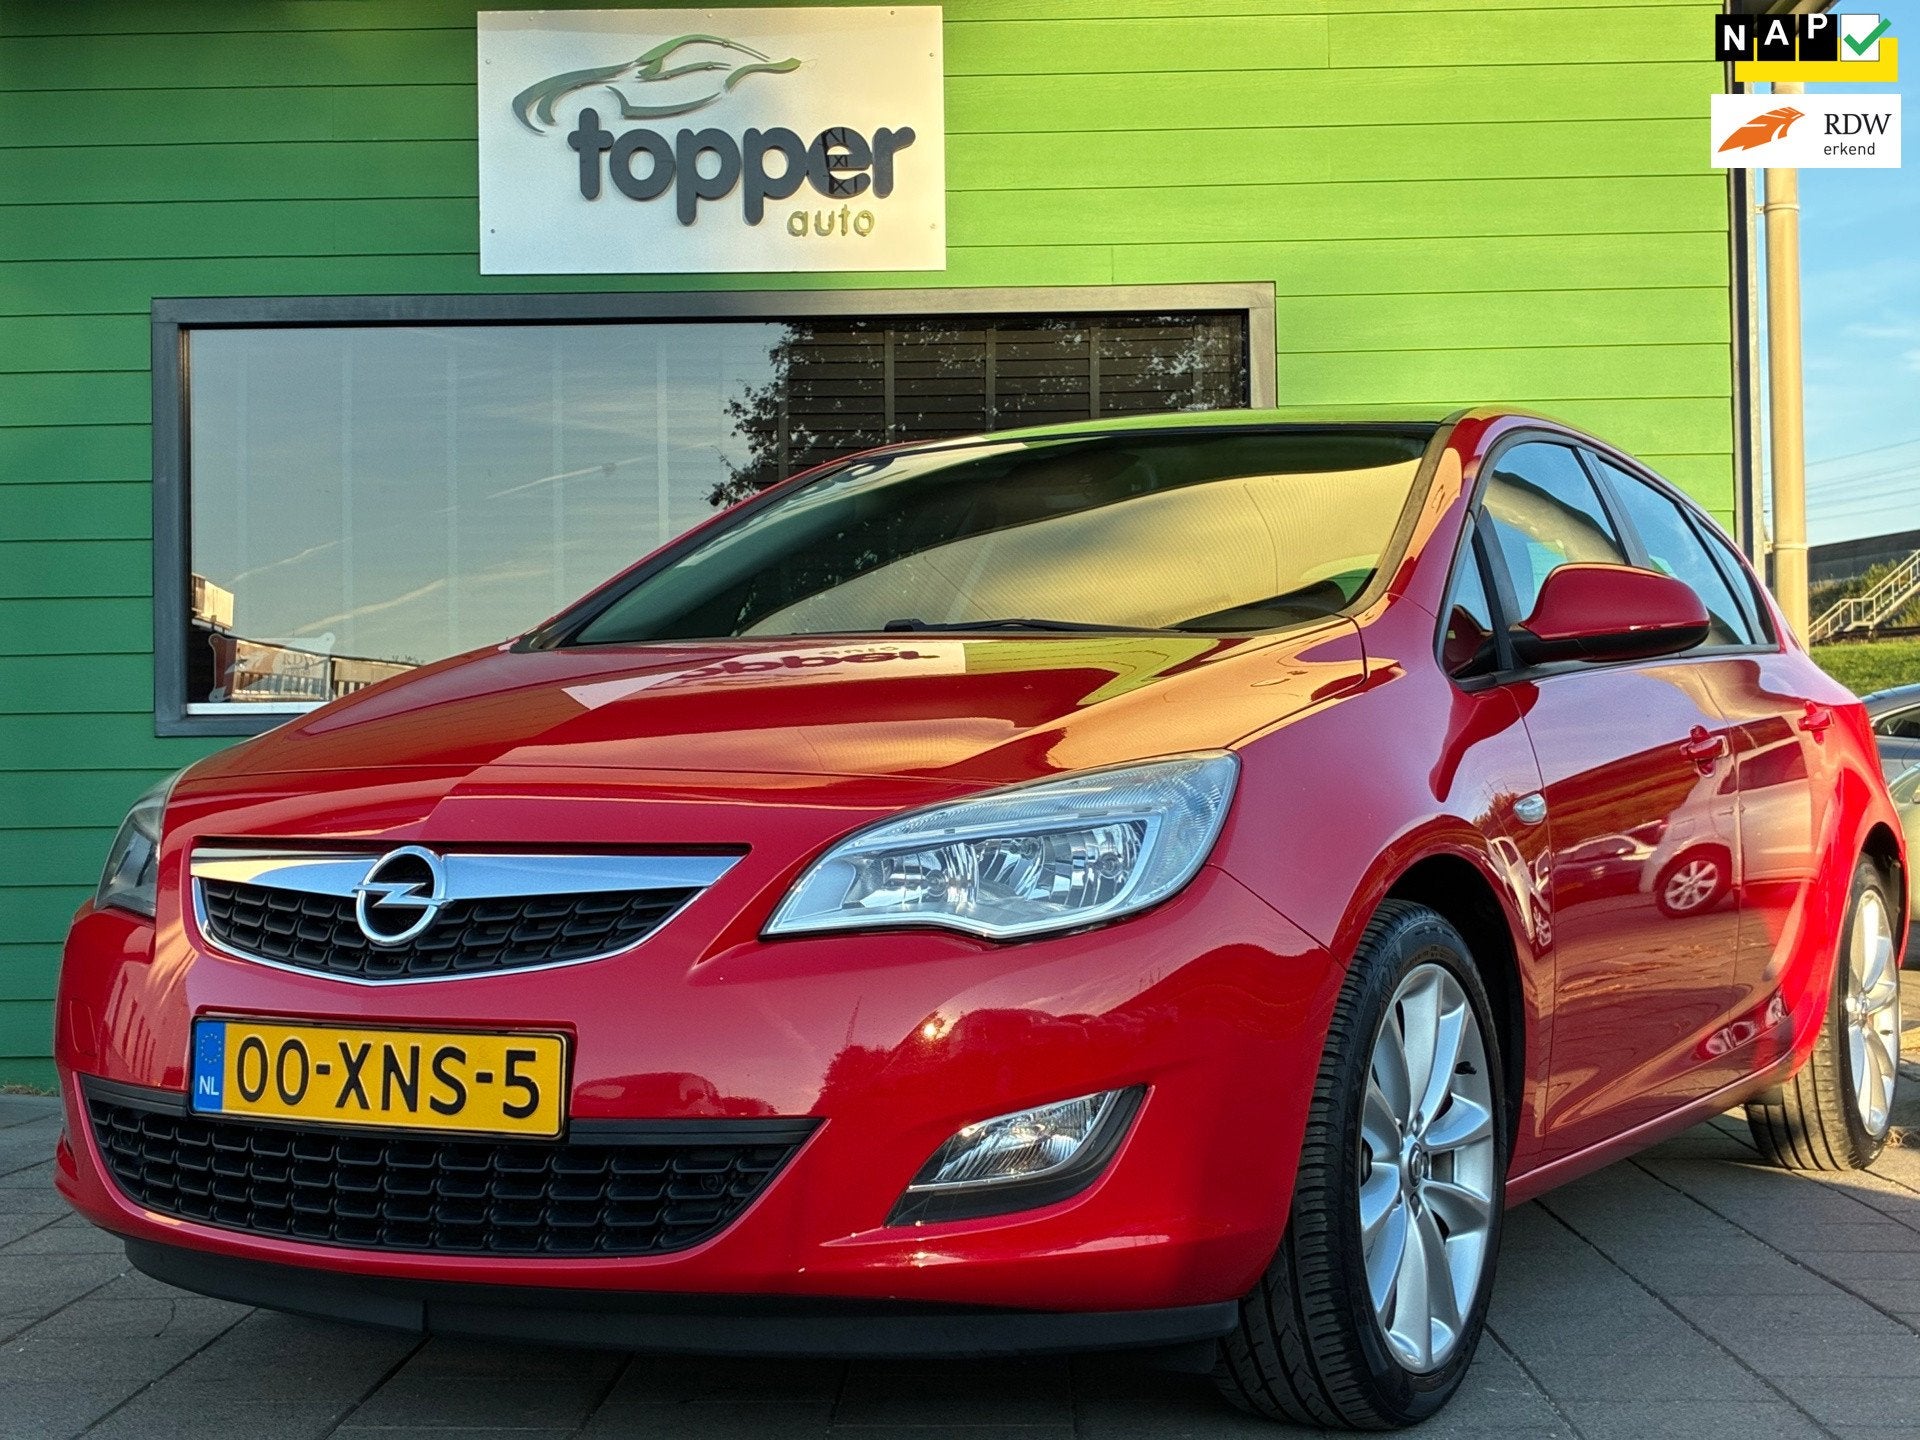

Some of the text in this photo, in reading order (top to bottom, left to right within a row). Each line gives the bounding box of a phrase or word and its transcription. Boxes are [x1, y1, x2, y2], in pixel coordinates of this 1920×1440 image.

[567, 107, 916, 226] topper
[786, 203, 875, 237] auto
[199, 1075, 220, 1097] NL
[236, 1035, 541, 1120] 00-XNS-5
